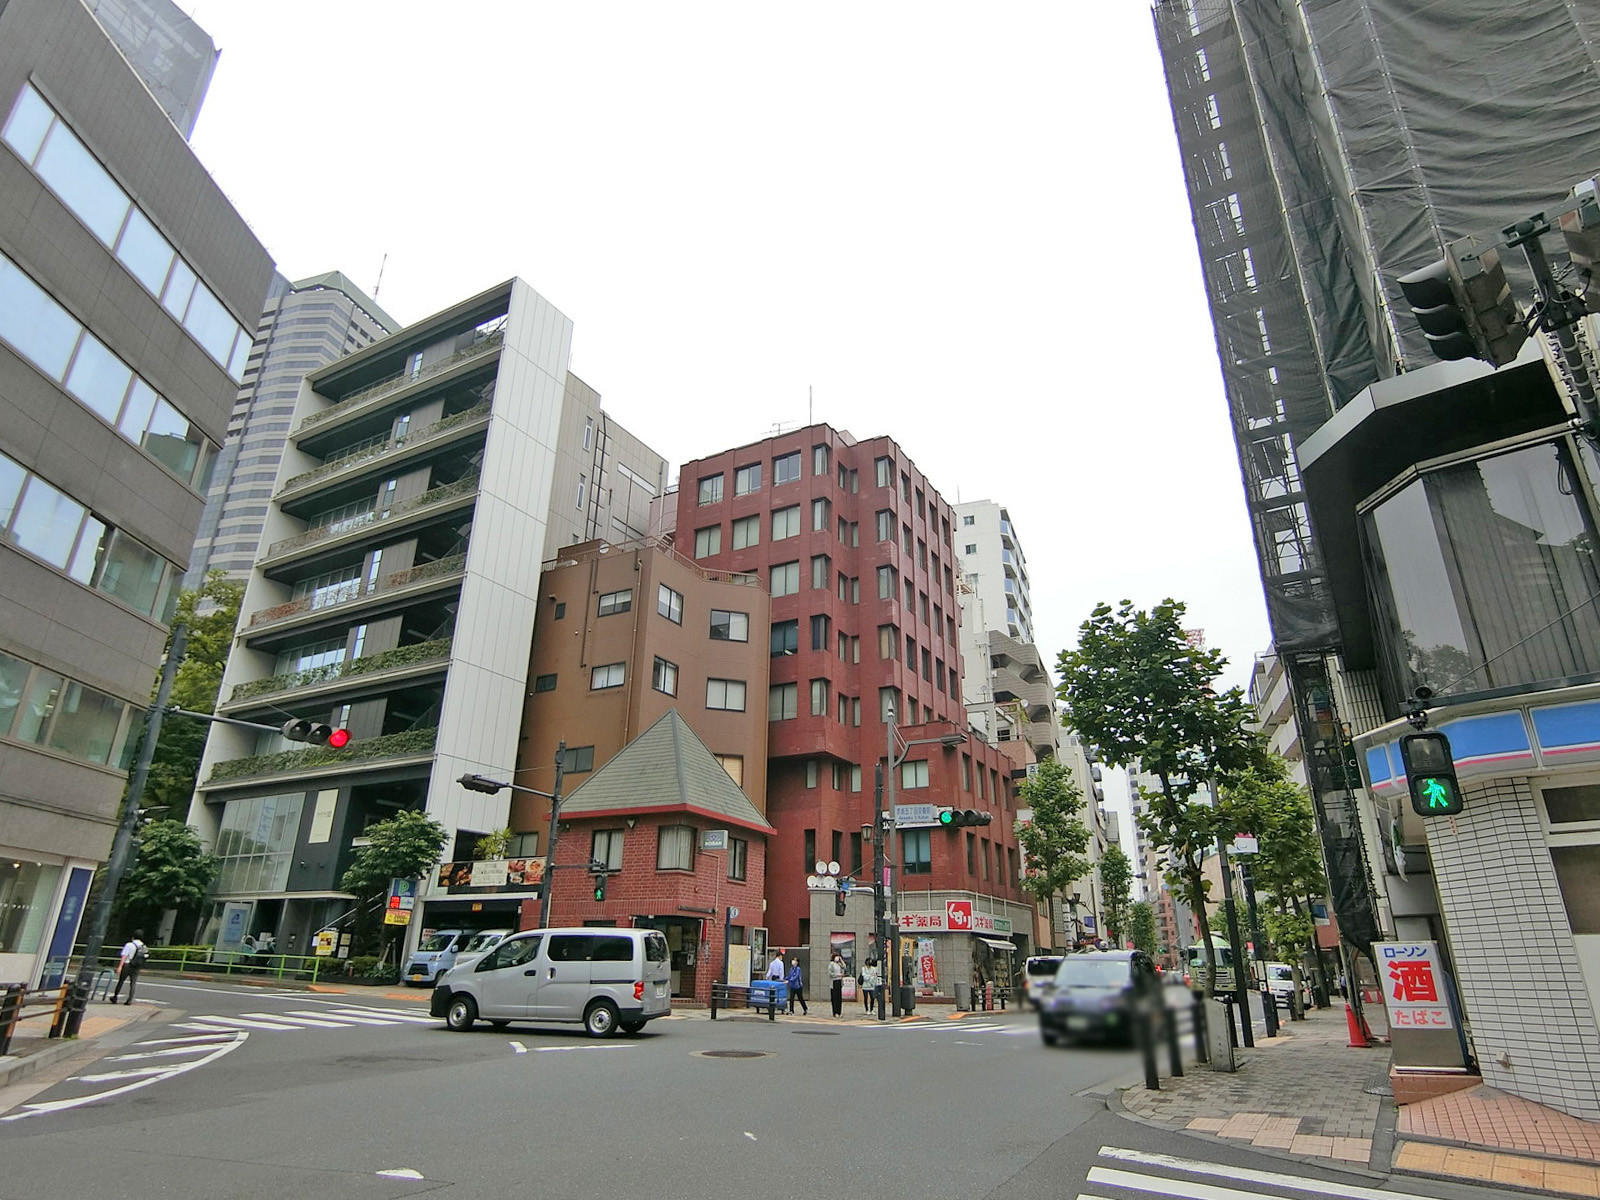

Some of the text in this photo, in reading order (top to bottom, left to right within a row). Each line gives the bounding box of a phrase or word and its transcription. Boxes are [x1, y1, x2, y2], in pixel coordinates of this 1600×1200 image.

[948, 903, 971, 929] くすり
[974, 916, 994, 930] スギ薬局
[1383, 946, 1427, 958] ローソン
[1387, 960, 1439, 1002] 酒
[1394, 1009, 1447, 1025] たばこ
